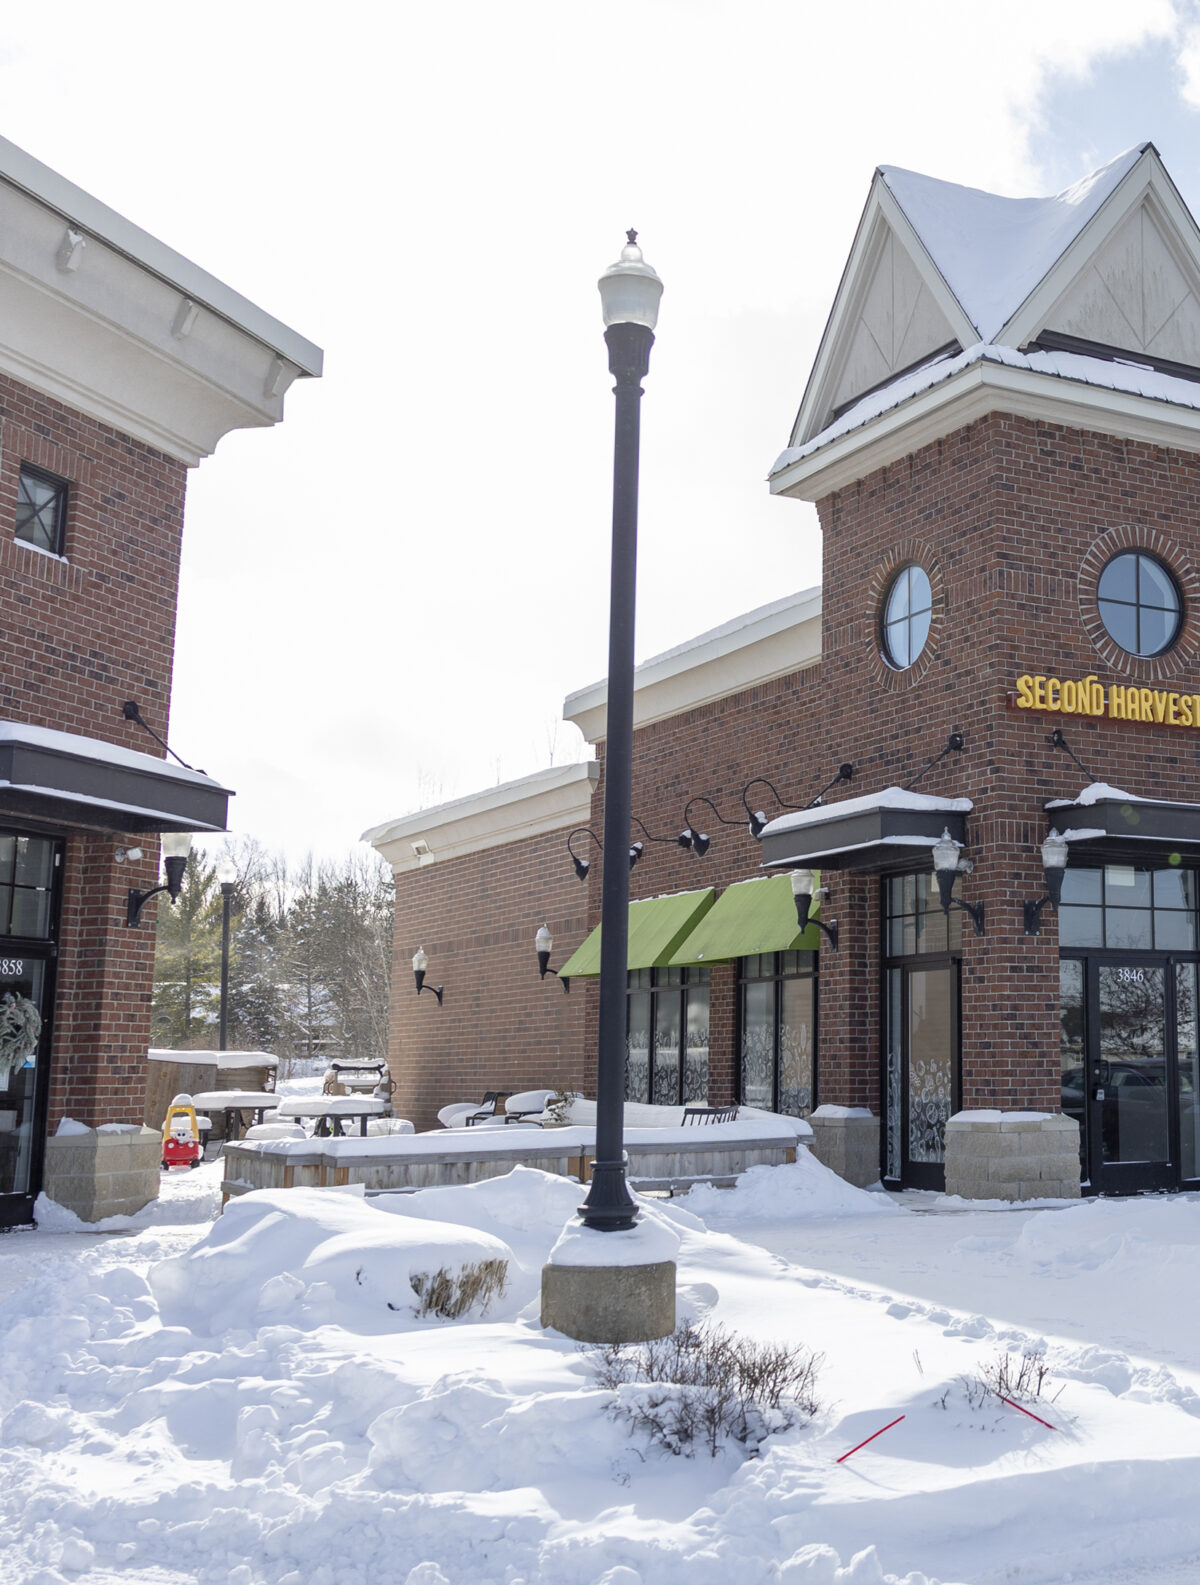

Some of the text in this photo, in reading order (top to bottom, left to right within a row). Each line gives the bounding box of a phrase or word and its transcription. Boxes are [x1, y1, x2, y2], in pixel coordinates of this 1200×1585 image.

[1016, 674, 1105, 716] SECOND
[0, 958, 23, 976] 858
[1117, 968, 1144, 983] 3846
